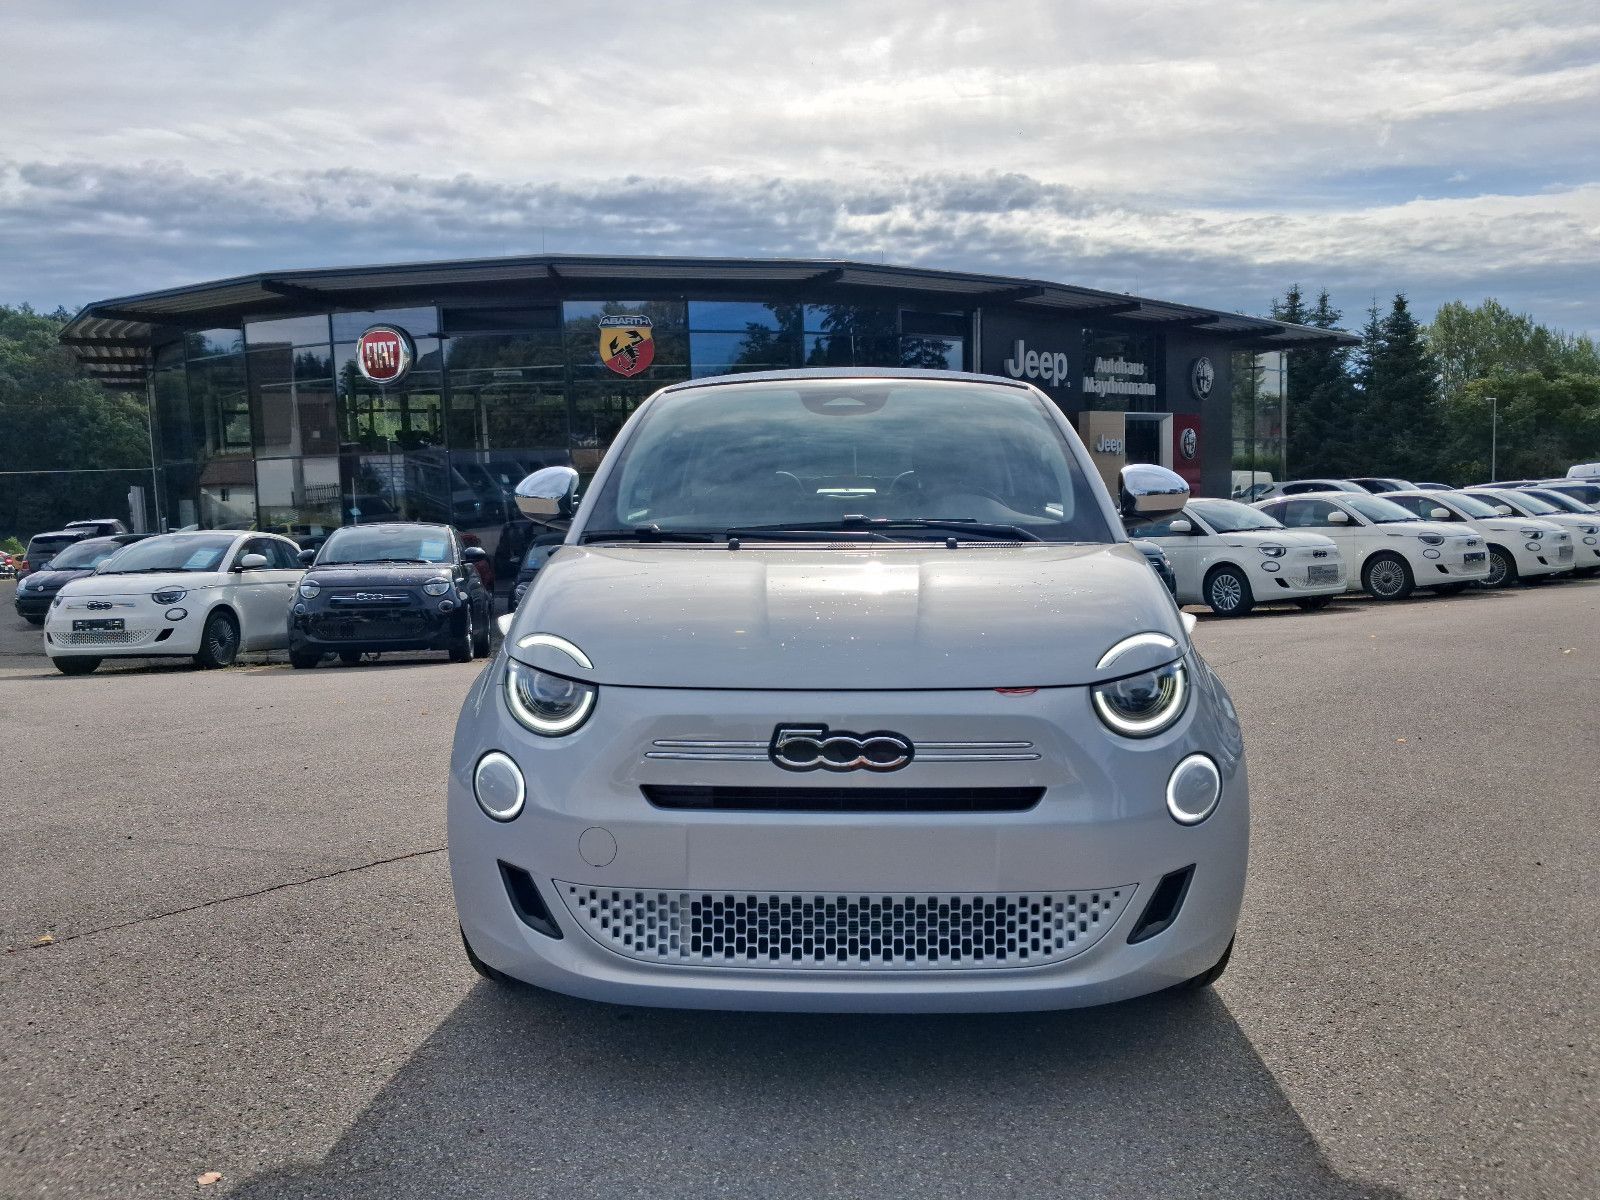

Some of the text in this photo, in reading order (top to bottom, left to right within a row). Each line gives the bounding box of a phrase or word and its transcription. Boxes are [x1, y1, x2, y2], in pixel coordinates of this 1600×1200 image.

[602, 317, 649, 325] ABARTH
[365, 341, 397, 369] FIAT
[1004, 339, 1068, 387] Jeep
[1094, 356, 1145, 376] Autohaus
[1097, 433, 1123, 455] Jeep
[773, 727, 911, 769] 500
